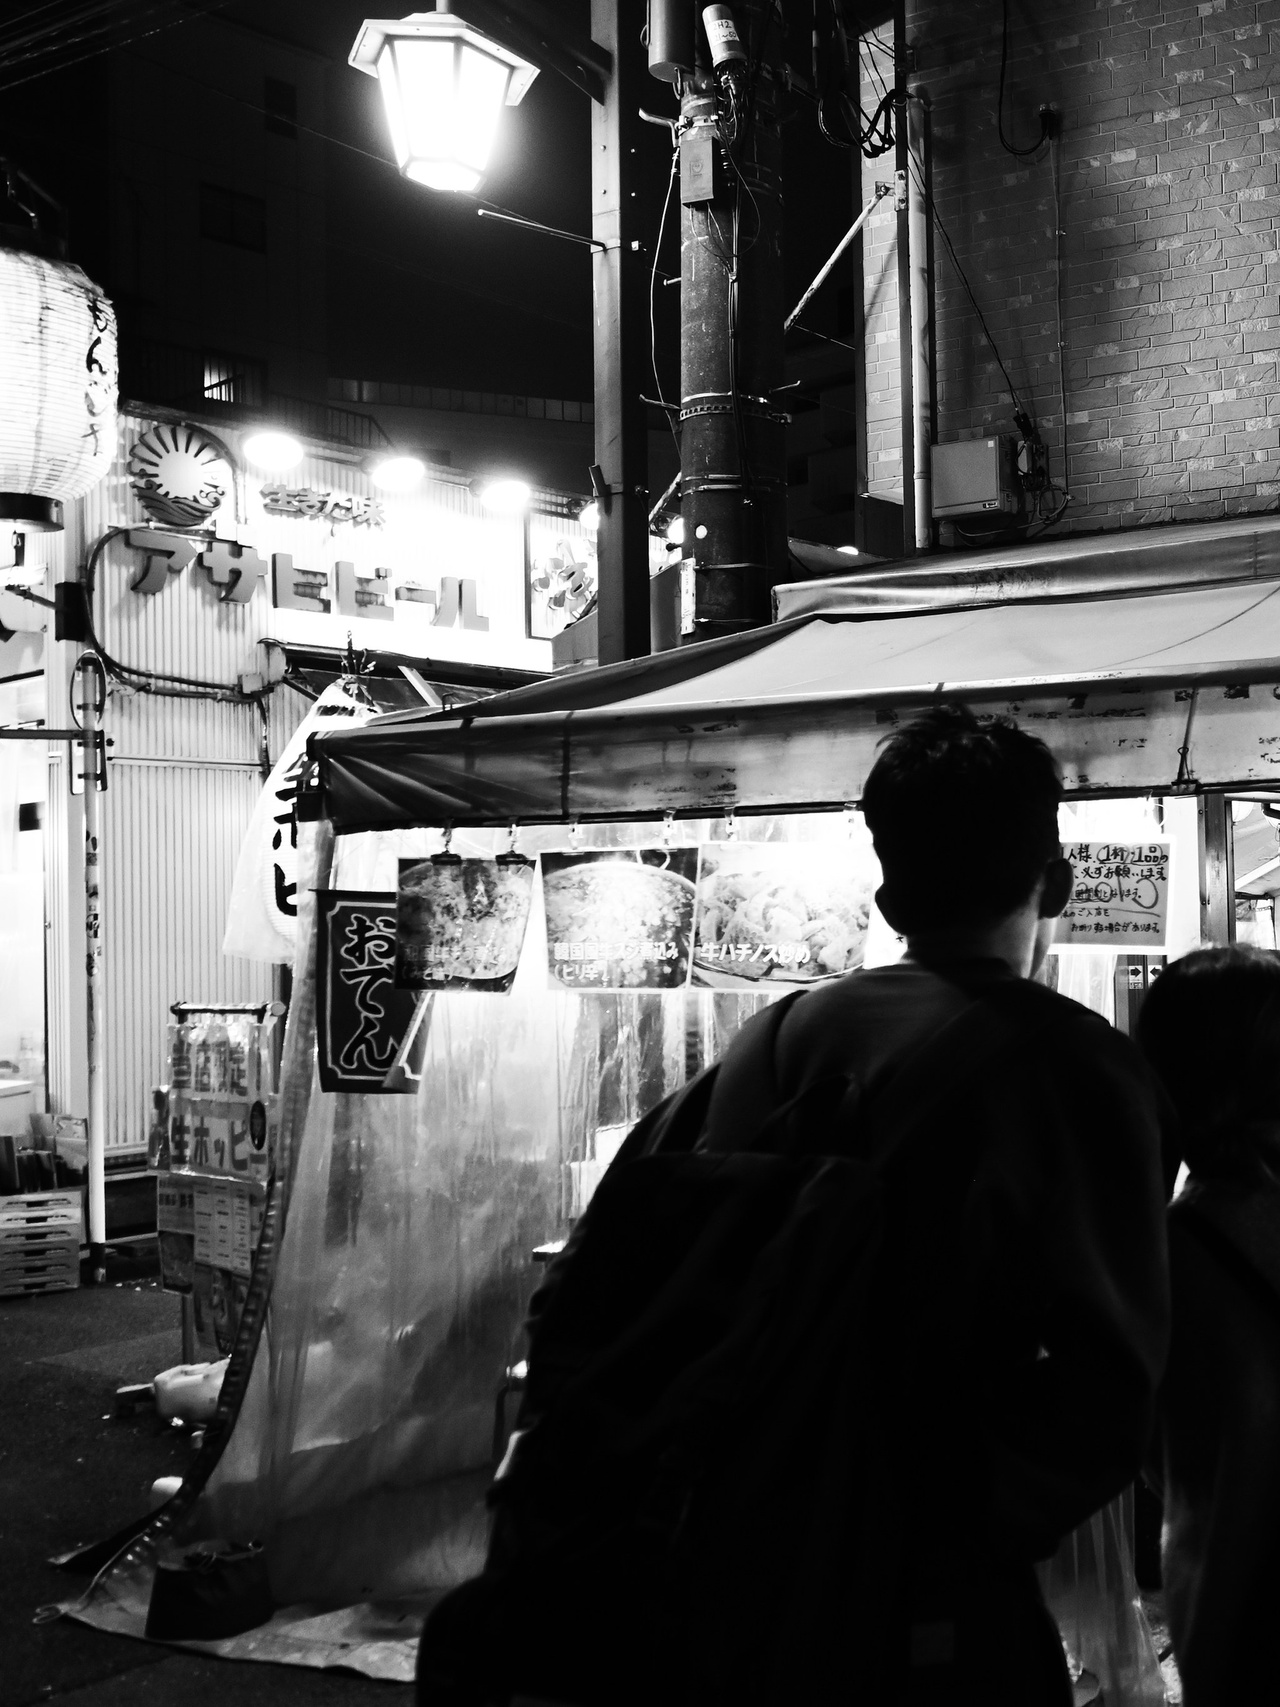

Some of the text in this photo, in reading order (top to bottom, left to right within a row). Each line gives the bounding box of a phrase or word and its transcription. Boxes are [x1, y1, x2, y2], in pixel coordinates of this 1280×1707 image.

[126, 531, 489, 632] アサヒビール
[700, 941, 812, 964] 牛ハチノス炒め
